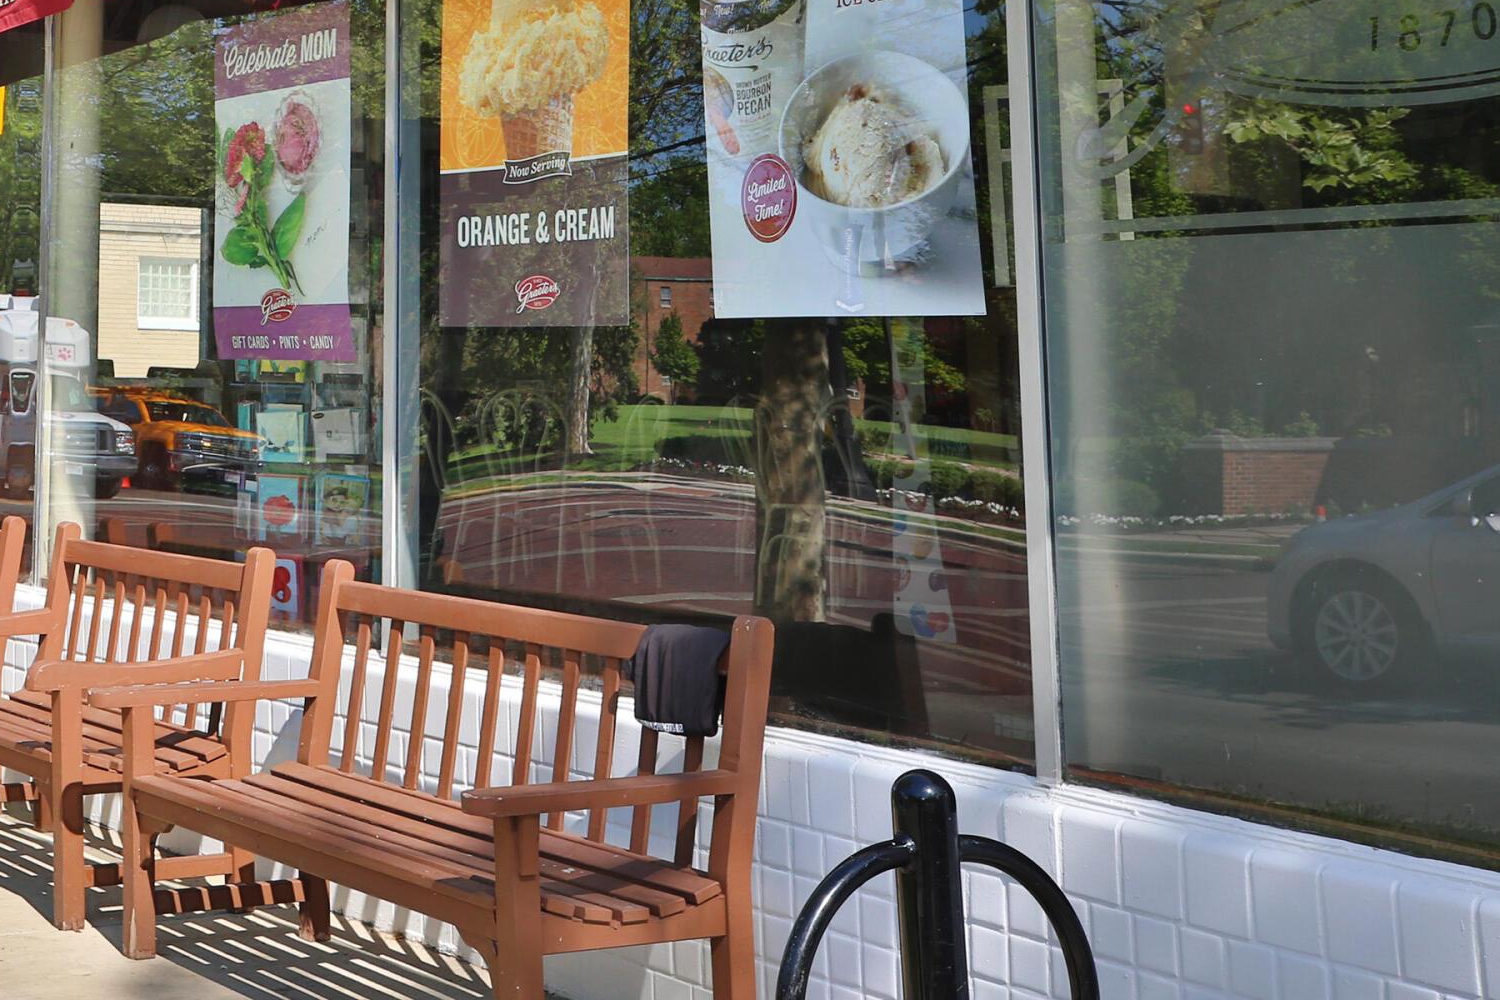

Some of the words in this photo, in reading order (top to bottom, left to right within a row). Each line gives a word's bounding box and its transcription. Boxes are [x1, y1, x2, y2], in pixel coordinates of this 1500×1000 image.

[1368, 2, 1498, 51] 1870
[223, 39, 297, 79] Celebrate
[300, 28, 337, 62] MOM
[736, 81, 772, 100] BOURBON
[737, 93, 771, 116] PECAN
[509, 165, 531, 178] Now
[531, 156, 566, 175] Serving
[747, 174, 787, 203] Limited
[754, 199, 785, 222] Time!
[457, 212, 531, 247] ORANGE
[535, 210, 550, 244] &
[554, 205, 615, 242] CREAM
[232, 336, 246, 349] GIFT
[247, 335, 270, 350] CARDS
[279, 335, 300, 349] PINTS
[309, 335, 334, 349] CANDY
